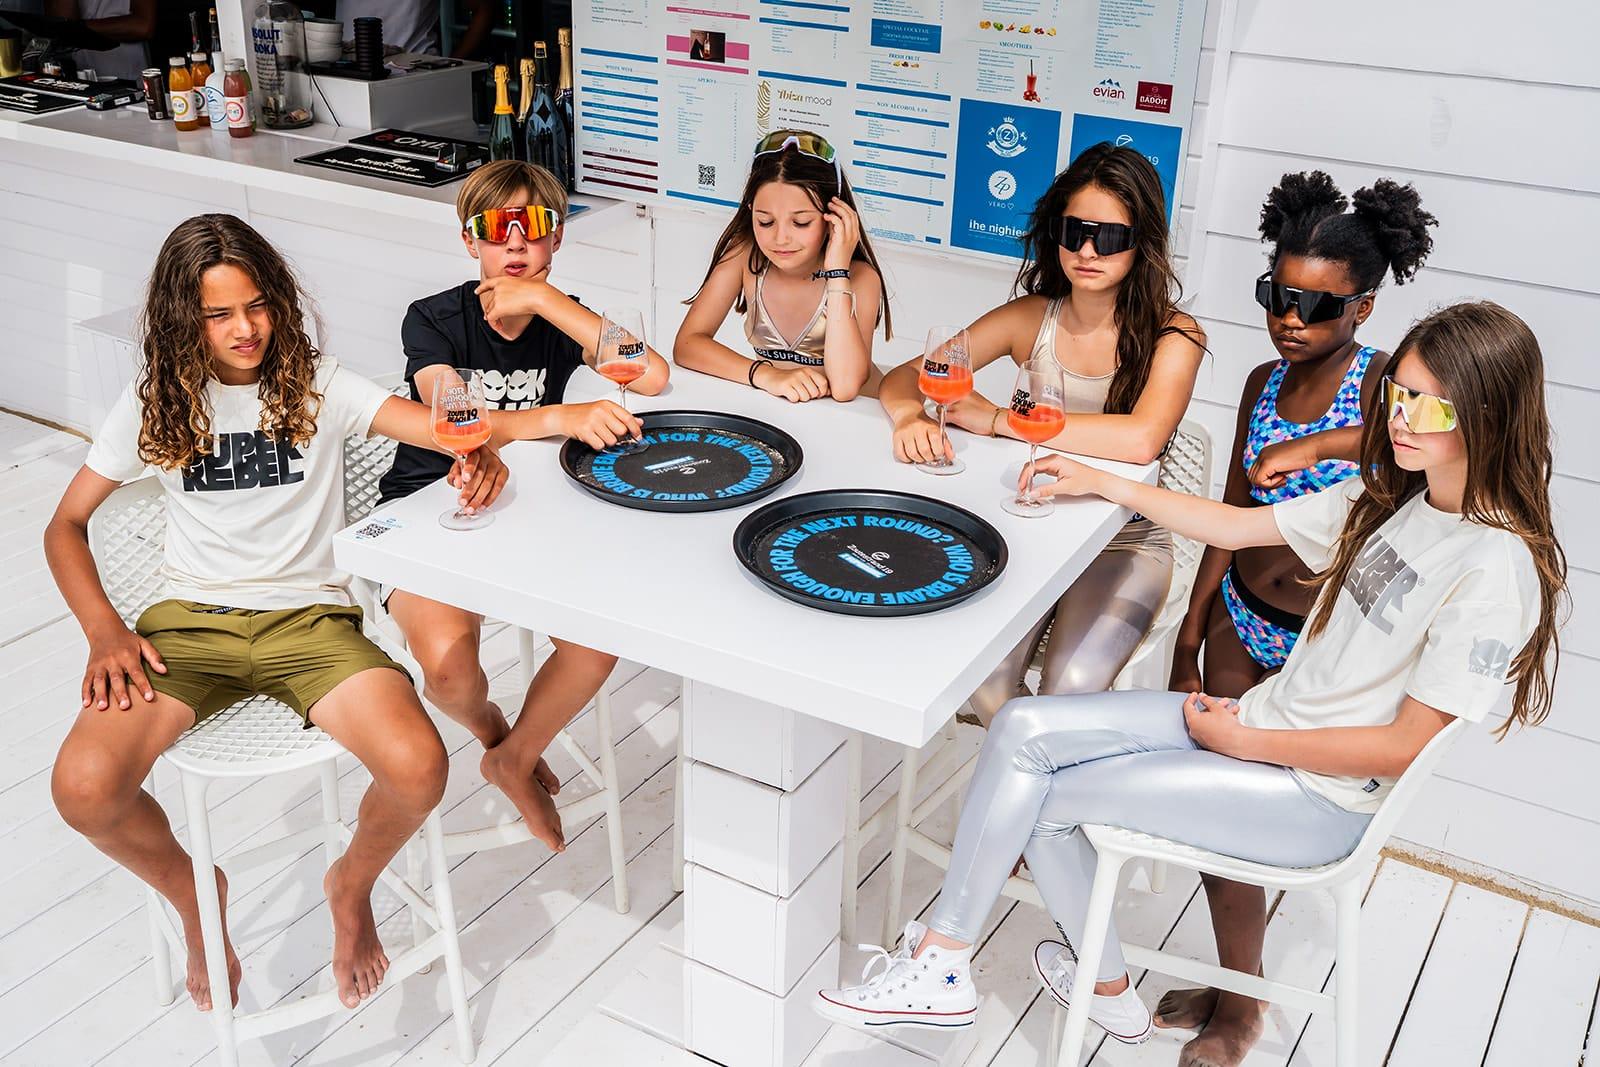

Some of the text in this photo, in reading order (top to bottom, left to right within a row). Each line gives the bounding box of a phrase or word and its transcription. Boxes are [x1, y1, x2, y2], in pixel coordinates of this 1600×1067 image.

[1093, 86, 1125, 99] evian
[805, 95, 832, 106] mood
[1139, 95, 1168, 105] BADOIT
[773, 350, 824, 365] SUPERRE
[937, 363, 949, 373] 19
[466, 408, 478, 421] 19
[658, 432, 700, 442] FOR
[704, 433, 741, 449] THE
[196, 429, 304, 468] UPER
[734, 443, 773, 465] NEXT
[591, 465, 636, 494] BRAVE
[715, 466, 773, 497] ROUND?
[629, 488, 653, 498] IS
[652, 492, 709, 501] WHO
[769, 515, 974, 605] WHO IS BRAVE ENOUGH FOR THE NEXT ROUND?
